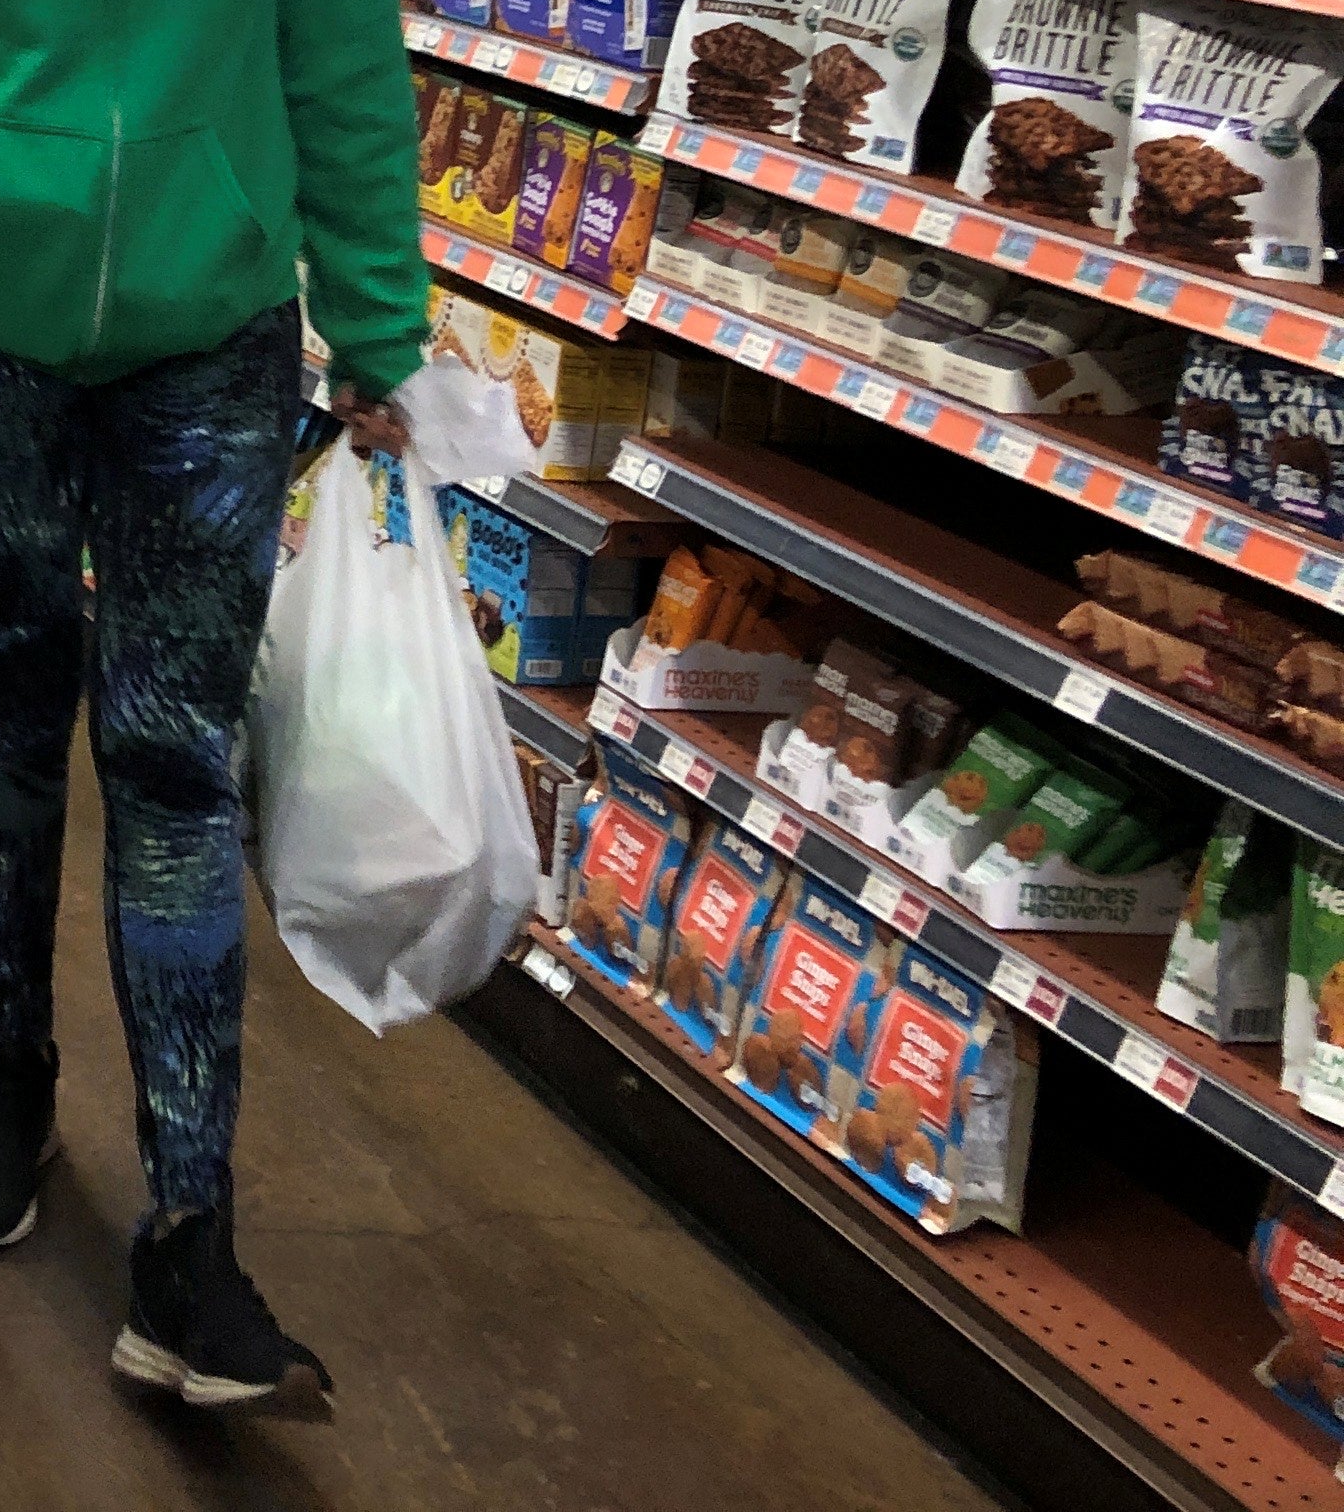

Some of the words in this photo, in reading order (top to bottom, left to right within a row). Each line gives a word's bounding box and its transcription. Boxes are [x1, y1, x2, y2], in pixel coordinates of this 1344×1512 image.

[994, 26, 1118, 76] BRITTLE
[662, 684, 759, 704] Heavenly
[664, 668, 760, 688] maxine's
[1020, 883, 1138, 906] maxine's
[793, 948, 839, 988] Ginger
[899, 1019, 949, 1057] Ginger
[897, 1038, 941, 1078] Snaps
